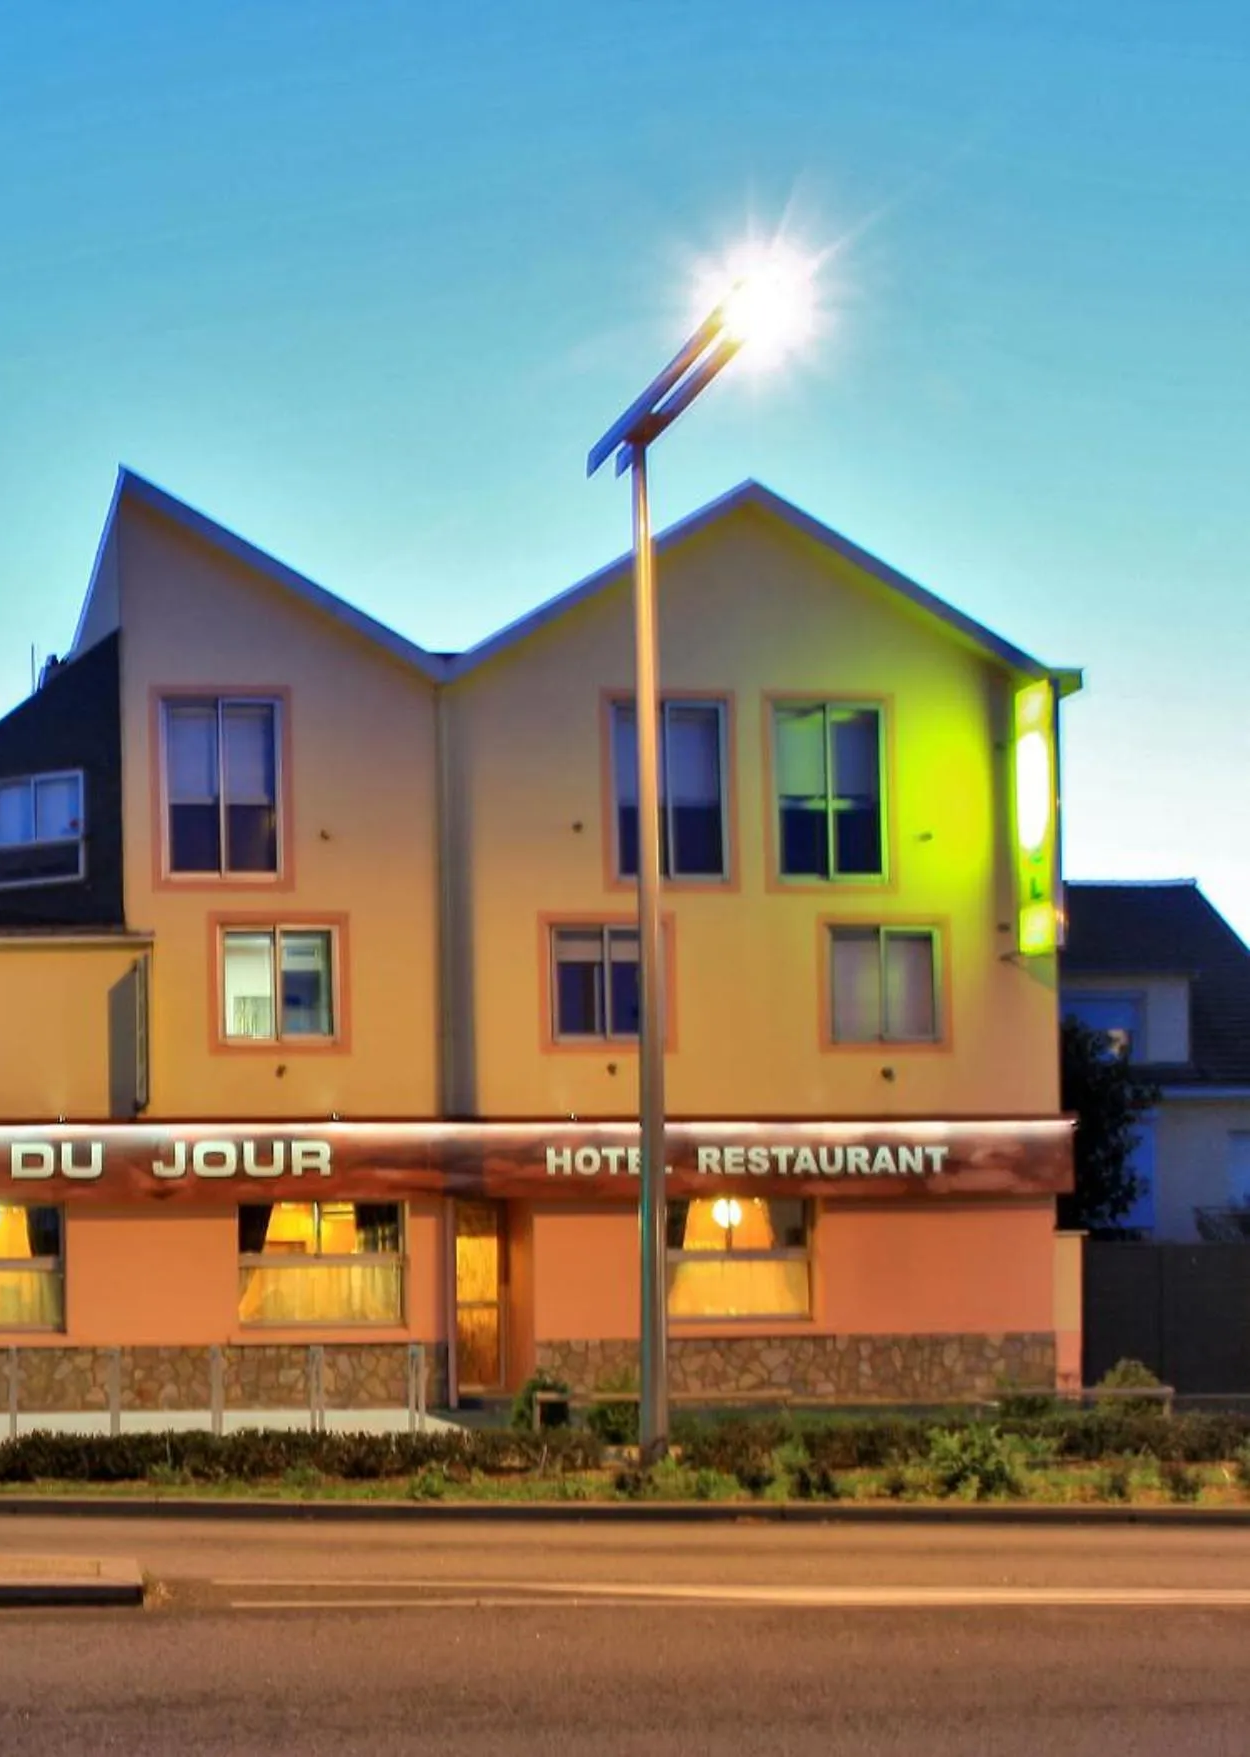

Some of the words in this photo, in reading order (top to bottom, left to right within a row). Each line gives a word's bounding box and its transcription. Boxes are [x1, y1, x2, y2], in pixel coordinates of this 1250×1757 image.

[10, 1141, 103, 1179] DU
[152, 1140, 332, 1177] JOUR
[546, 1145, 673, 1175] HOTE
[697, 1145, 949, 1175] RESTAURANT
